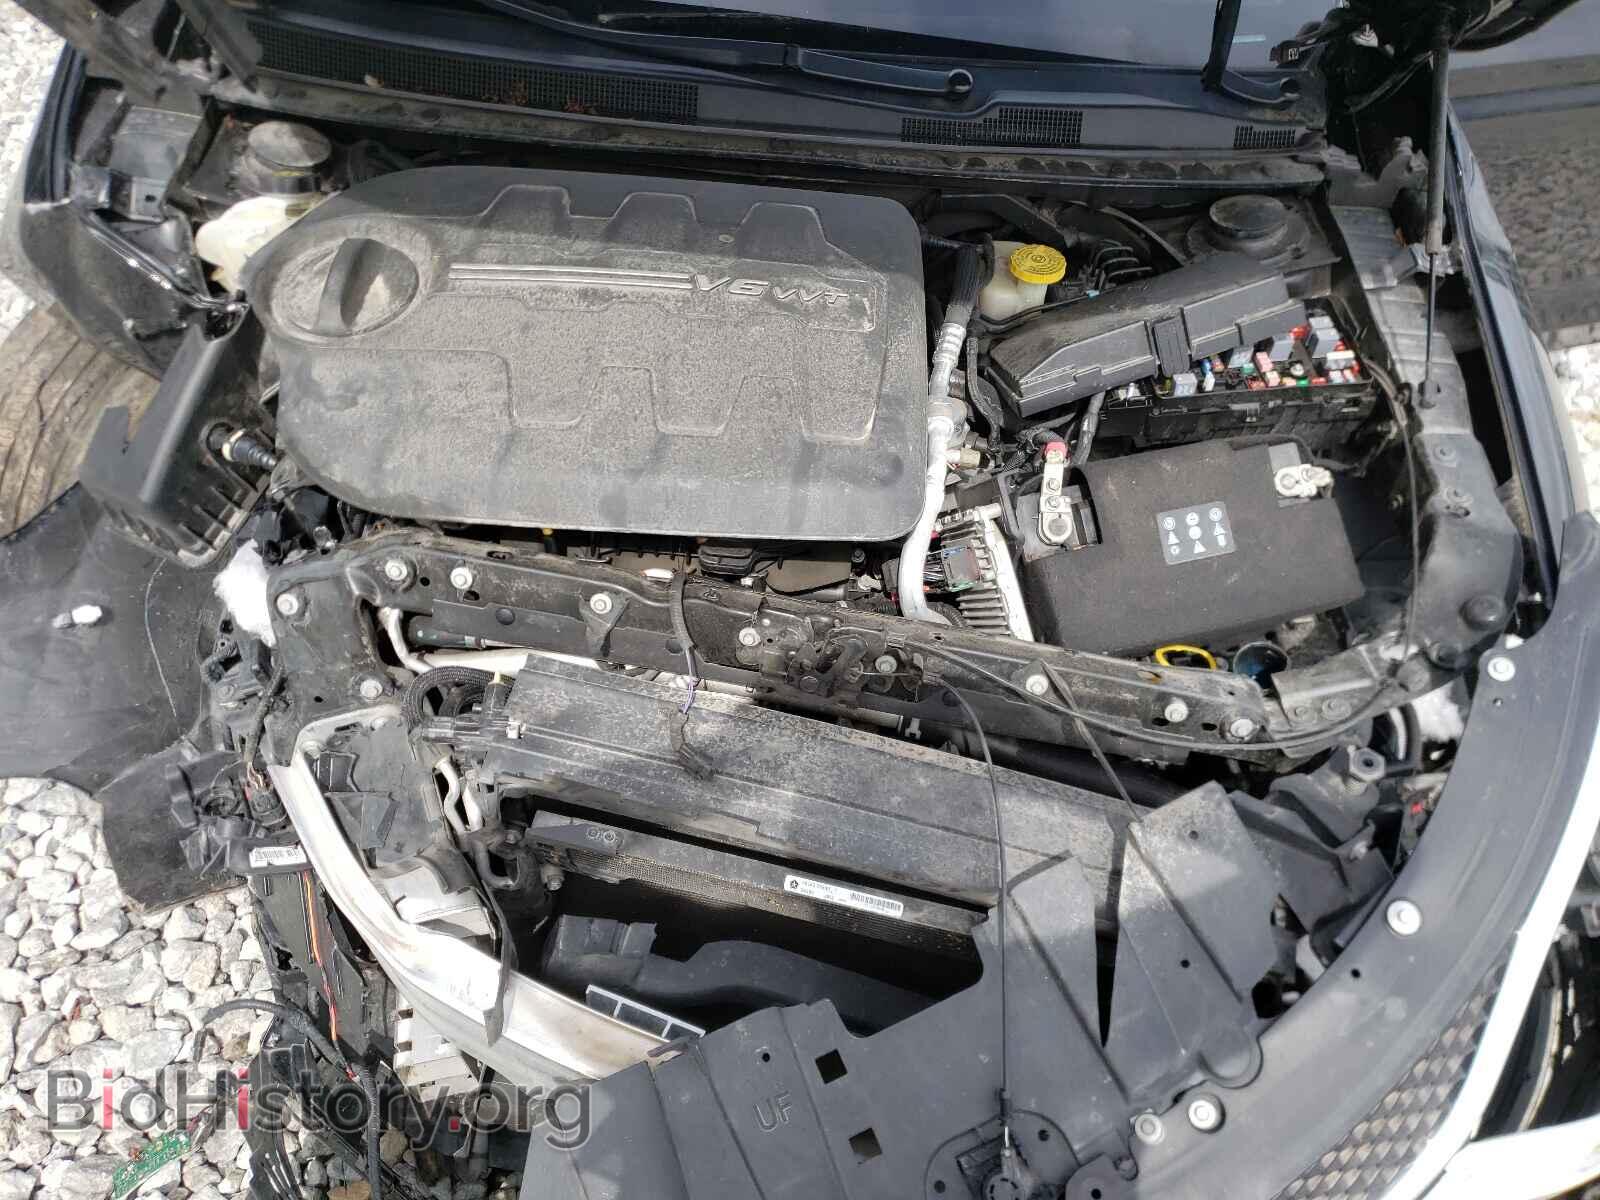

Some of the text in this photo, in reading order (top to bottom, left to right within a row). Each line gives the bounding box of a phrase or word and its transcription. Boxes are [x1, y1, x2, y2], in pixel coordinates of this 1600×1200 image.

[694, 274, 848, 305] V6 VVT
[752, 1089, 794, 1133] UF
